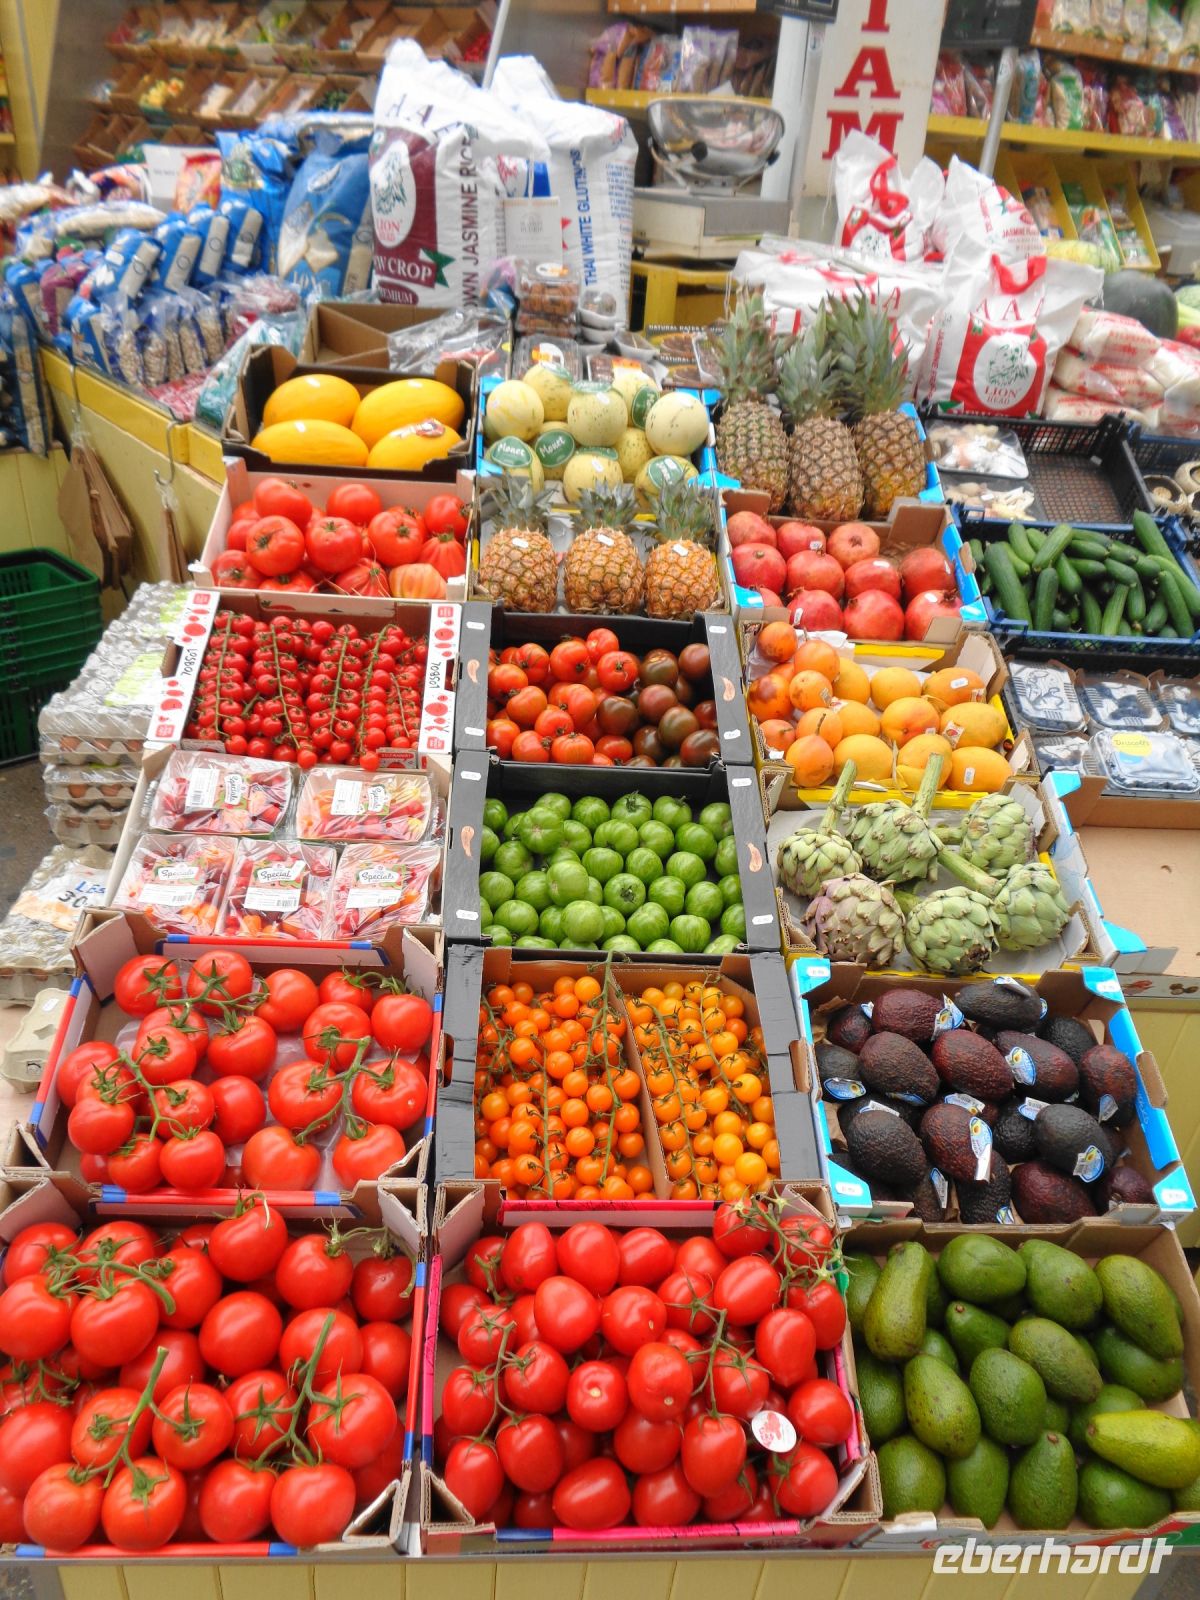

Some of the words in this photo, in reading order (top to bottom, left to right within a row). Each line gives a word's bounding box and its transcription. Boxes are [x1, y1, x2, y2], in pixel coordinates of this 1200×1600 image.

[461, 182, 479, 266] JASMINE
[578, 215, 595, 255] WHITE
[387, 256, 433, 283] CROP
[584, 258, 598, 287] THAI
[985, 385, 1019, 399] LION
[497, 442, 526, 457] Monet
[539, 435, 566, 458] Monet
[228, 776, 239, 802] Specials
[361, 871, 395, 883] Specials
